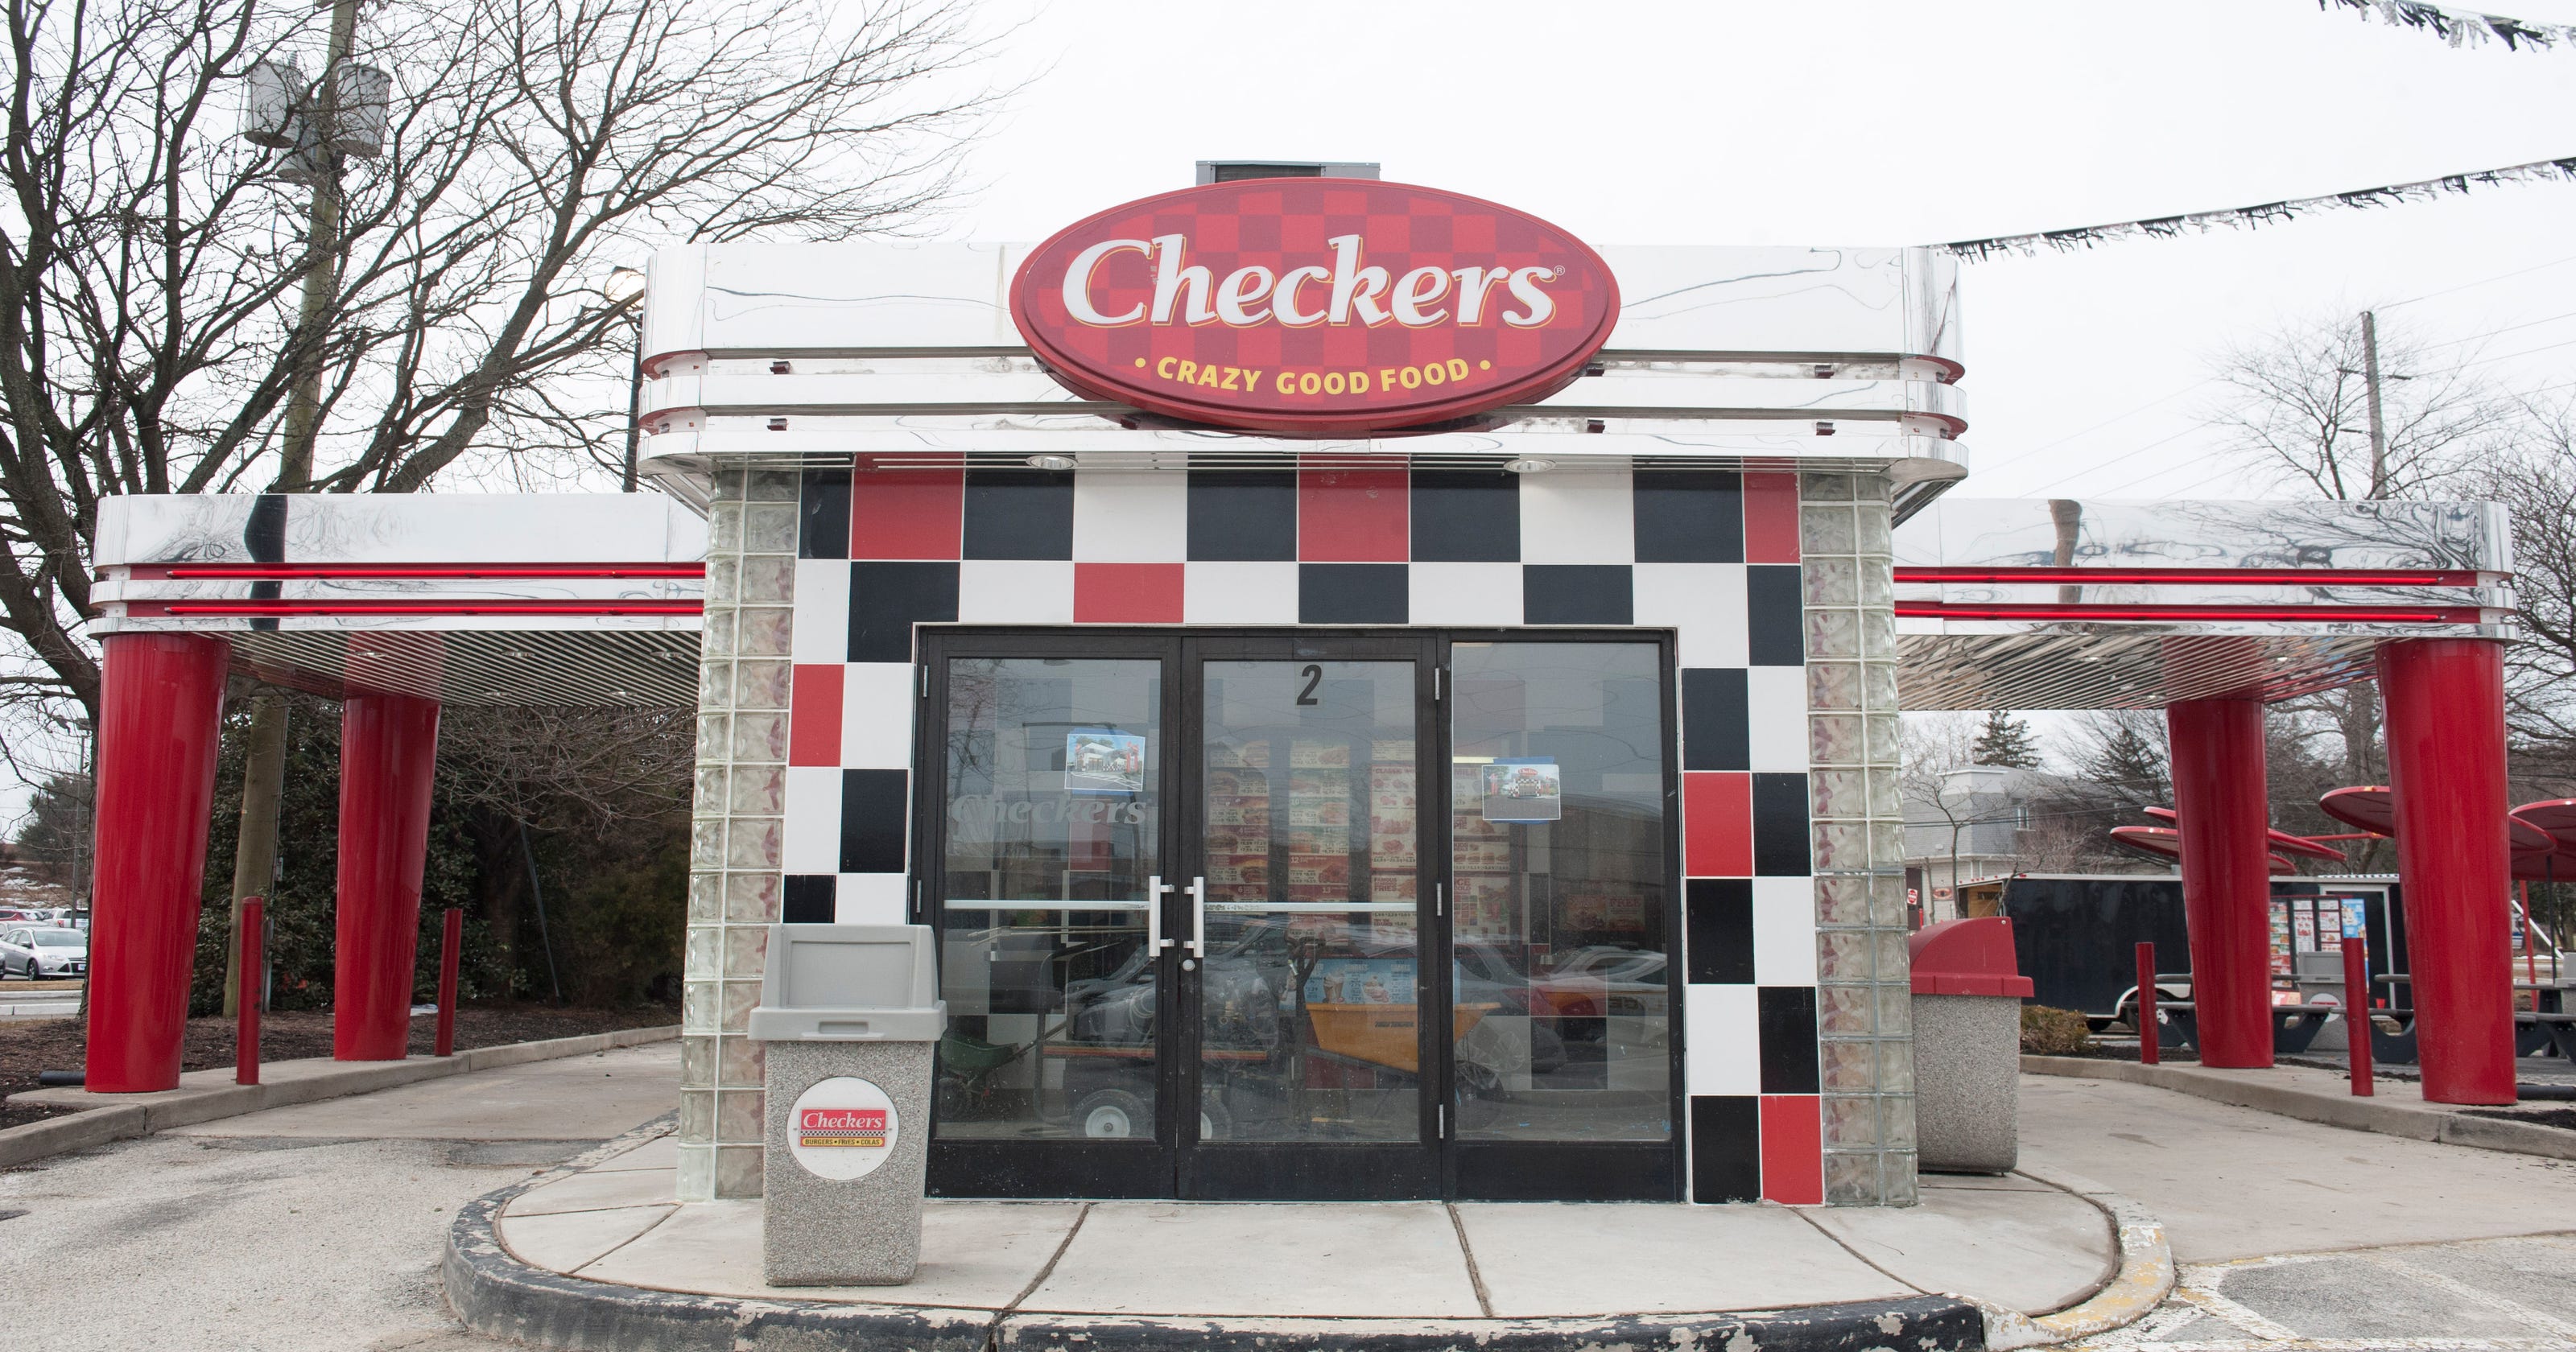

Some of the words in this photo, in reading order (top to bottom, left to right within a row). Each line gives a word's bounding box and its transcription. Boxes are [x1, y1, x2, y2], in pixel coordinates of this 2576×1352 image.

[1061, 233, 1558, 328] Checkers
[1157, 355, 1262, 394] CRAZY
[1275, 371, 1370, 395] GOOD
[1381, 358, 1470, 393] FOOD
[1296, 664, 1323, 706] 2
[951, 792, 1147, 825] Checkers
[803, 1112, 883, 1128] Checkers
